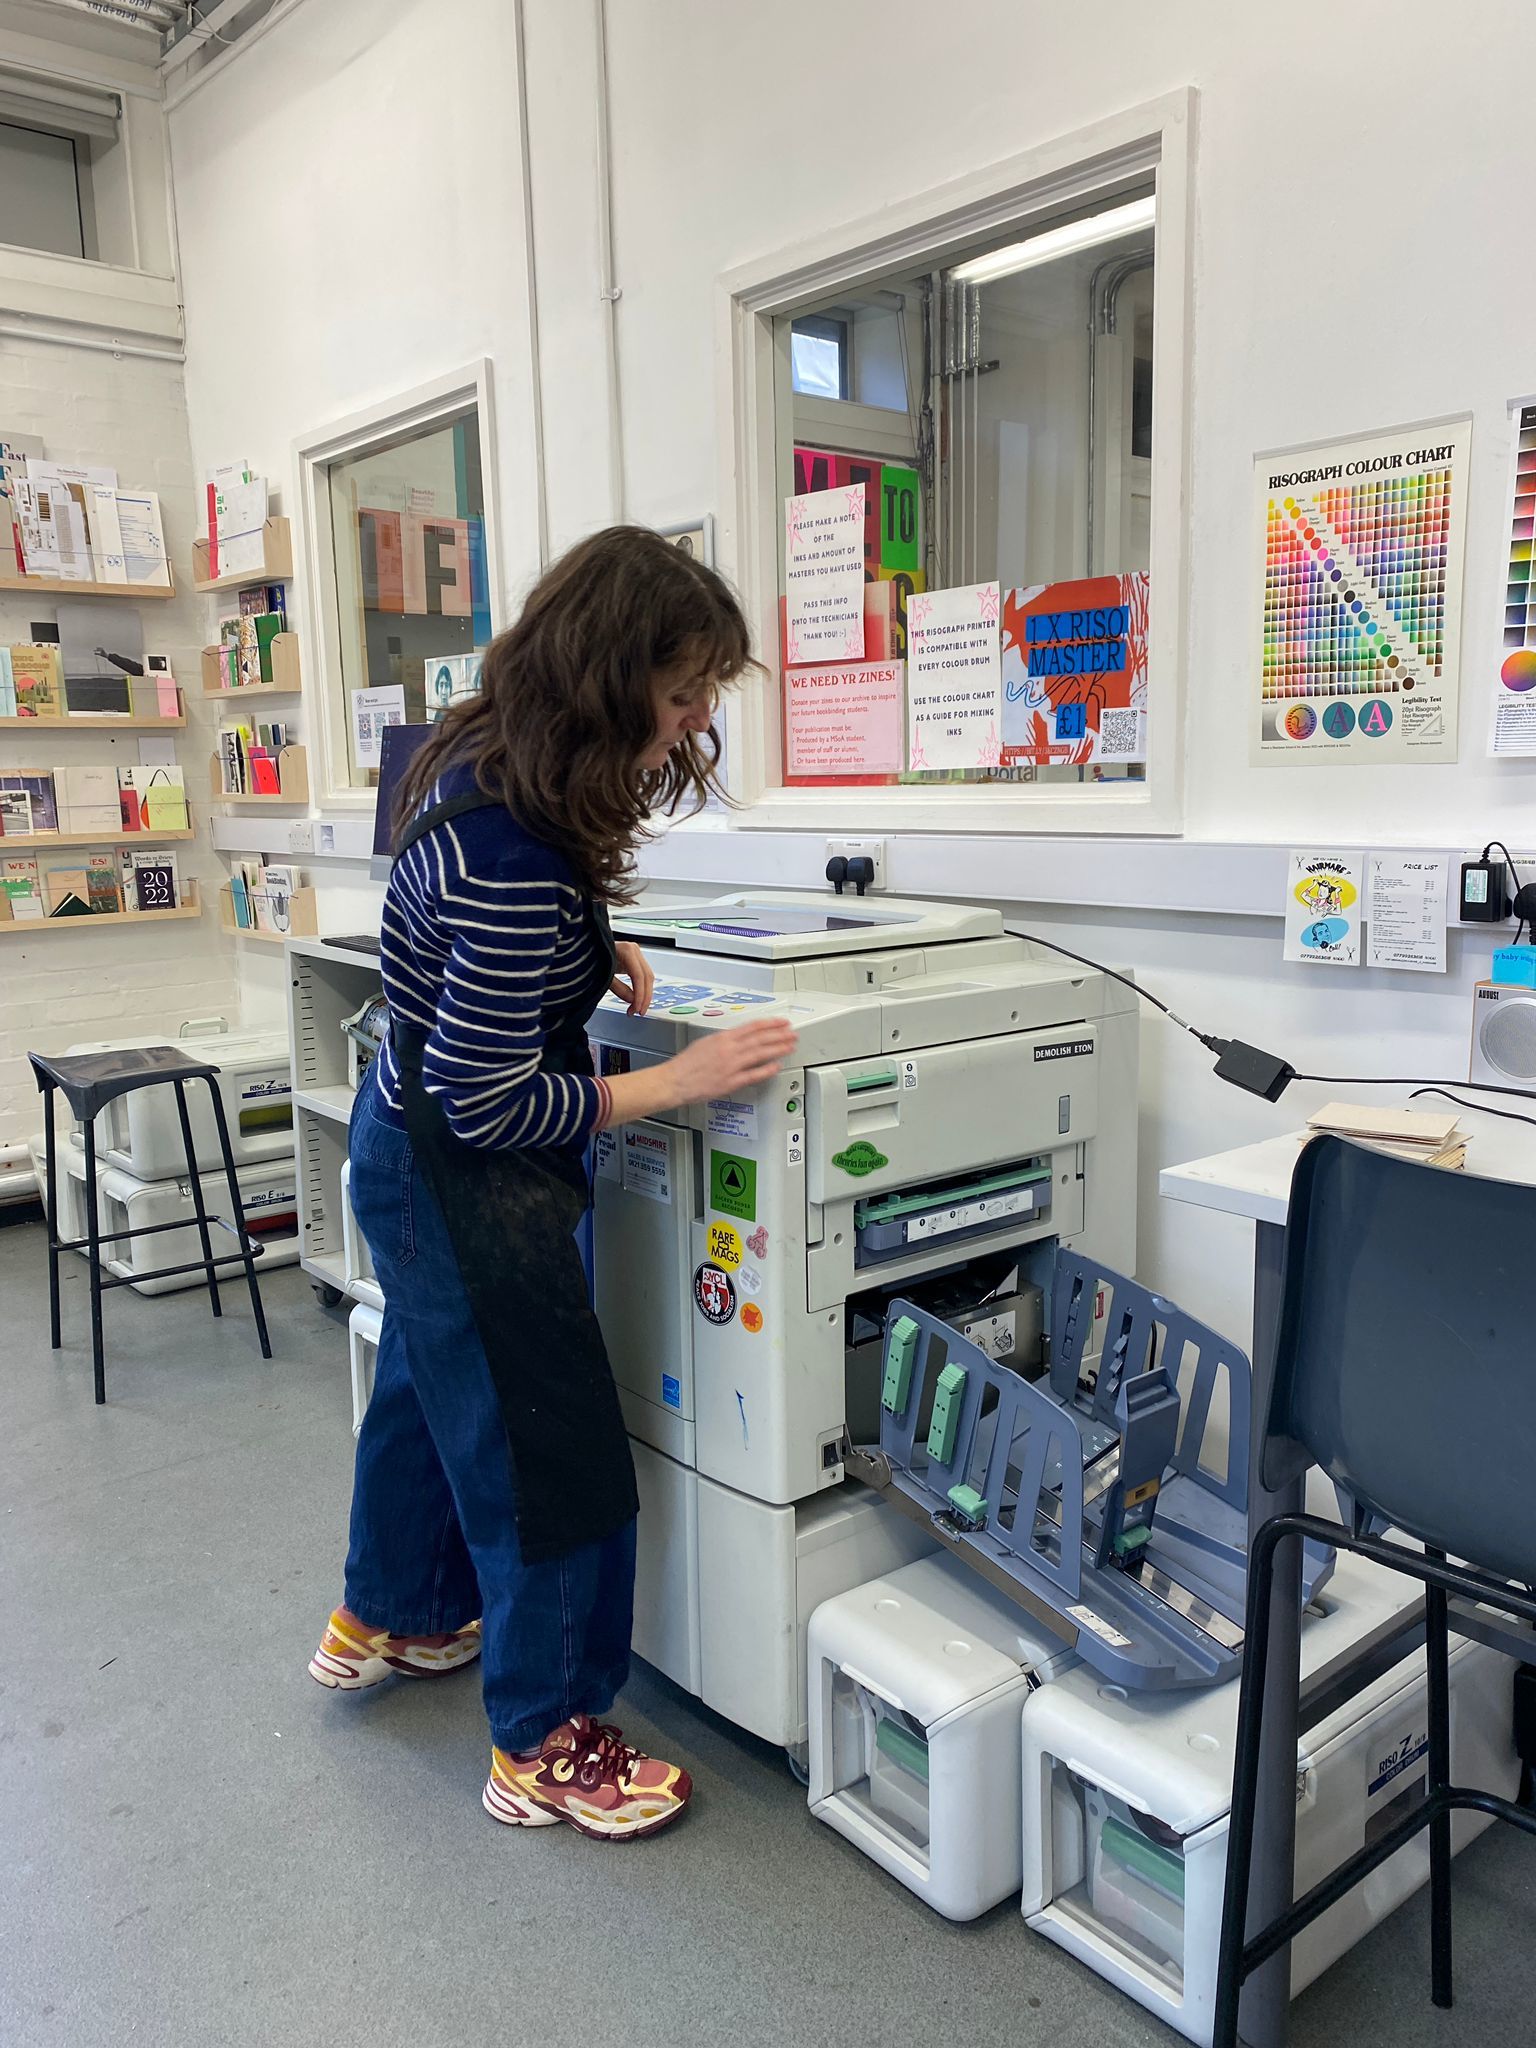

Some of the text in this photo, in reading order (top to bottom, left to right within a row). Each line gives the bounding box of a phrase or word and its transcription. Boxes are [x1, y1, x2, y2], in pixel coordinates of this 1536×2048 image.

[1268, 445, 1456, 489] RISOGRAPH COLOUR CHART
[793, 513, 856, 531] PLEASE MAKE A NOTE
[883, 484, 915, 544] TO
[813, 533, 835, 543] OF THE
[793, 546, 856, 563] INKS AND AMOUNT OF
[788, 562, 862, 579] MASTERS YOU HAVE USED
[803, 597, 848, 609] PASS THIS INFO
[791, 612, 858, 626] ONTO THE TECHNICIANS
[1029, 608, 1124, 645] 1 X RISO
[803, 630, 838, 640] THANK YOU!
[910, 619, 996, 639] THIS RISOGRAPH PRINTER
[918, 638, 988, 655] IS COMPATIBLE WITH
[918, 656, 990, 672] EVERY COLOUR DRUM
[1029, 640, 1121, 677] MASTER
[791, 670, 895, 689] WE NEED YR ZINES!
[809, 698, 820, 708] your
[852, 694, 870, 702] archive
[913, 690, 995, 706] USE THE COLOUR CHART
[1401, 697, 1428, 705] Legibility
[915, 707, 995, 722] AS A GUIDE FOR MIXING
[1365, 703, 1388, 731] A
[1415, 705, 1441, 713] Risograph
[1058, 705, 1083, 736] £1
[1327, 703, 1350, 732] A
[796, 736, 818, 744] Produced
[819, 736, 825, 744] by
[946, 728, 962, 737] INKS
[8, 862, 25, 870] WE
[1305, 862, 1347, 874] HAIRMARE
[143, 871, 168, 887] 20
[145, 888, 169, 904] 22
[1501, 953, 1520, 961] baby
[1478, 989, 1500, 1000] AUGUST
[1035, 1043, 1093, 1059] DEMOLISH ETON
[250, 1080, 276, 1091] RISO Z
[636, 1134, 667, 1151] MIDSHIRE
[251, 1190, 274, 1202] RISO E
[712, 1228, 734, 1245] RARE
[711, 1245, 740, 1264] MAGS
[709, 1314, 720, 1322] AND
[720, 1295, 734, 1321] SOCIALISM
[1379, 1733, 1412, 1775] RISO Z
